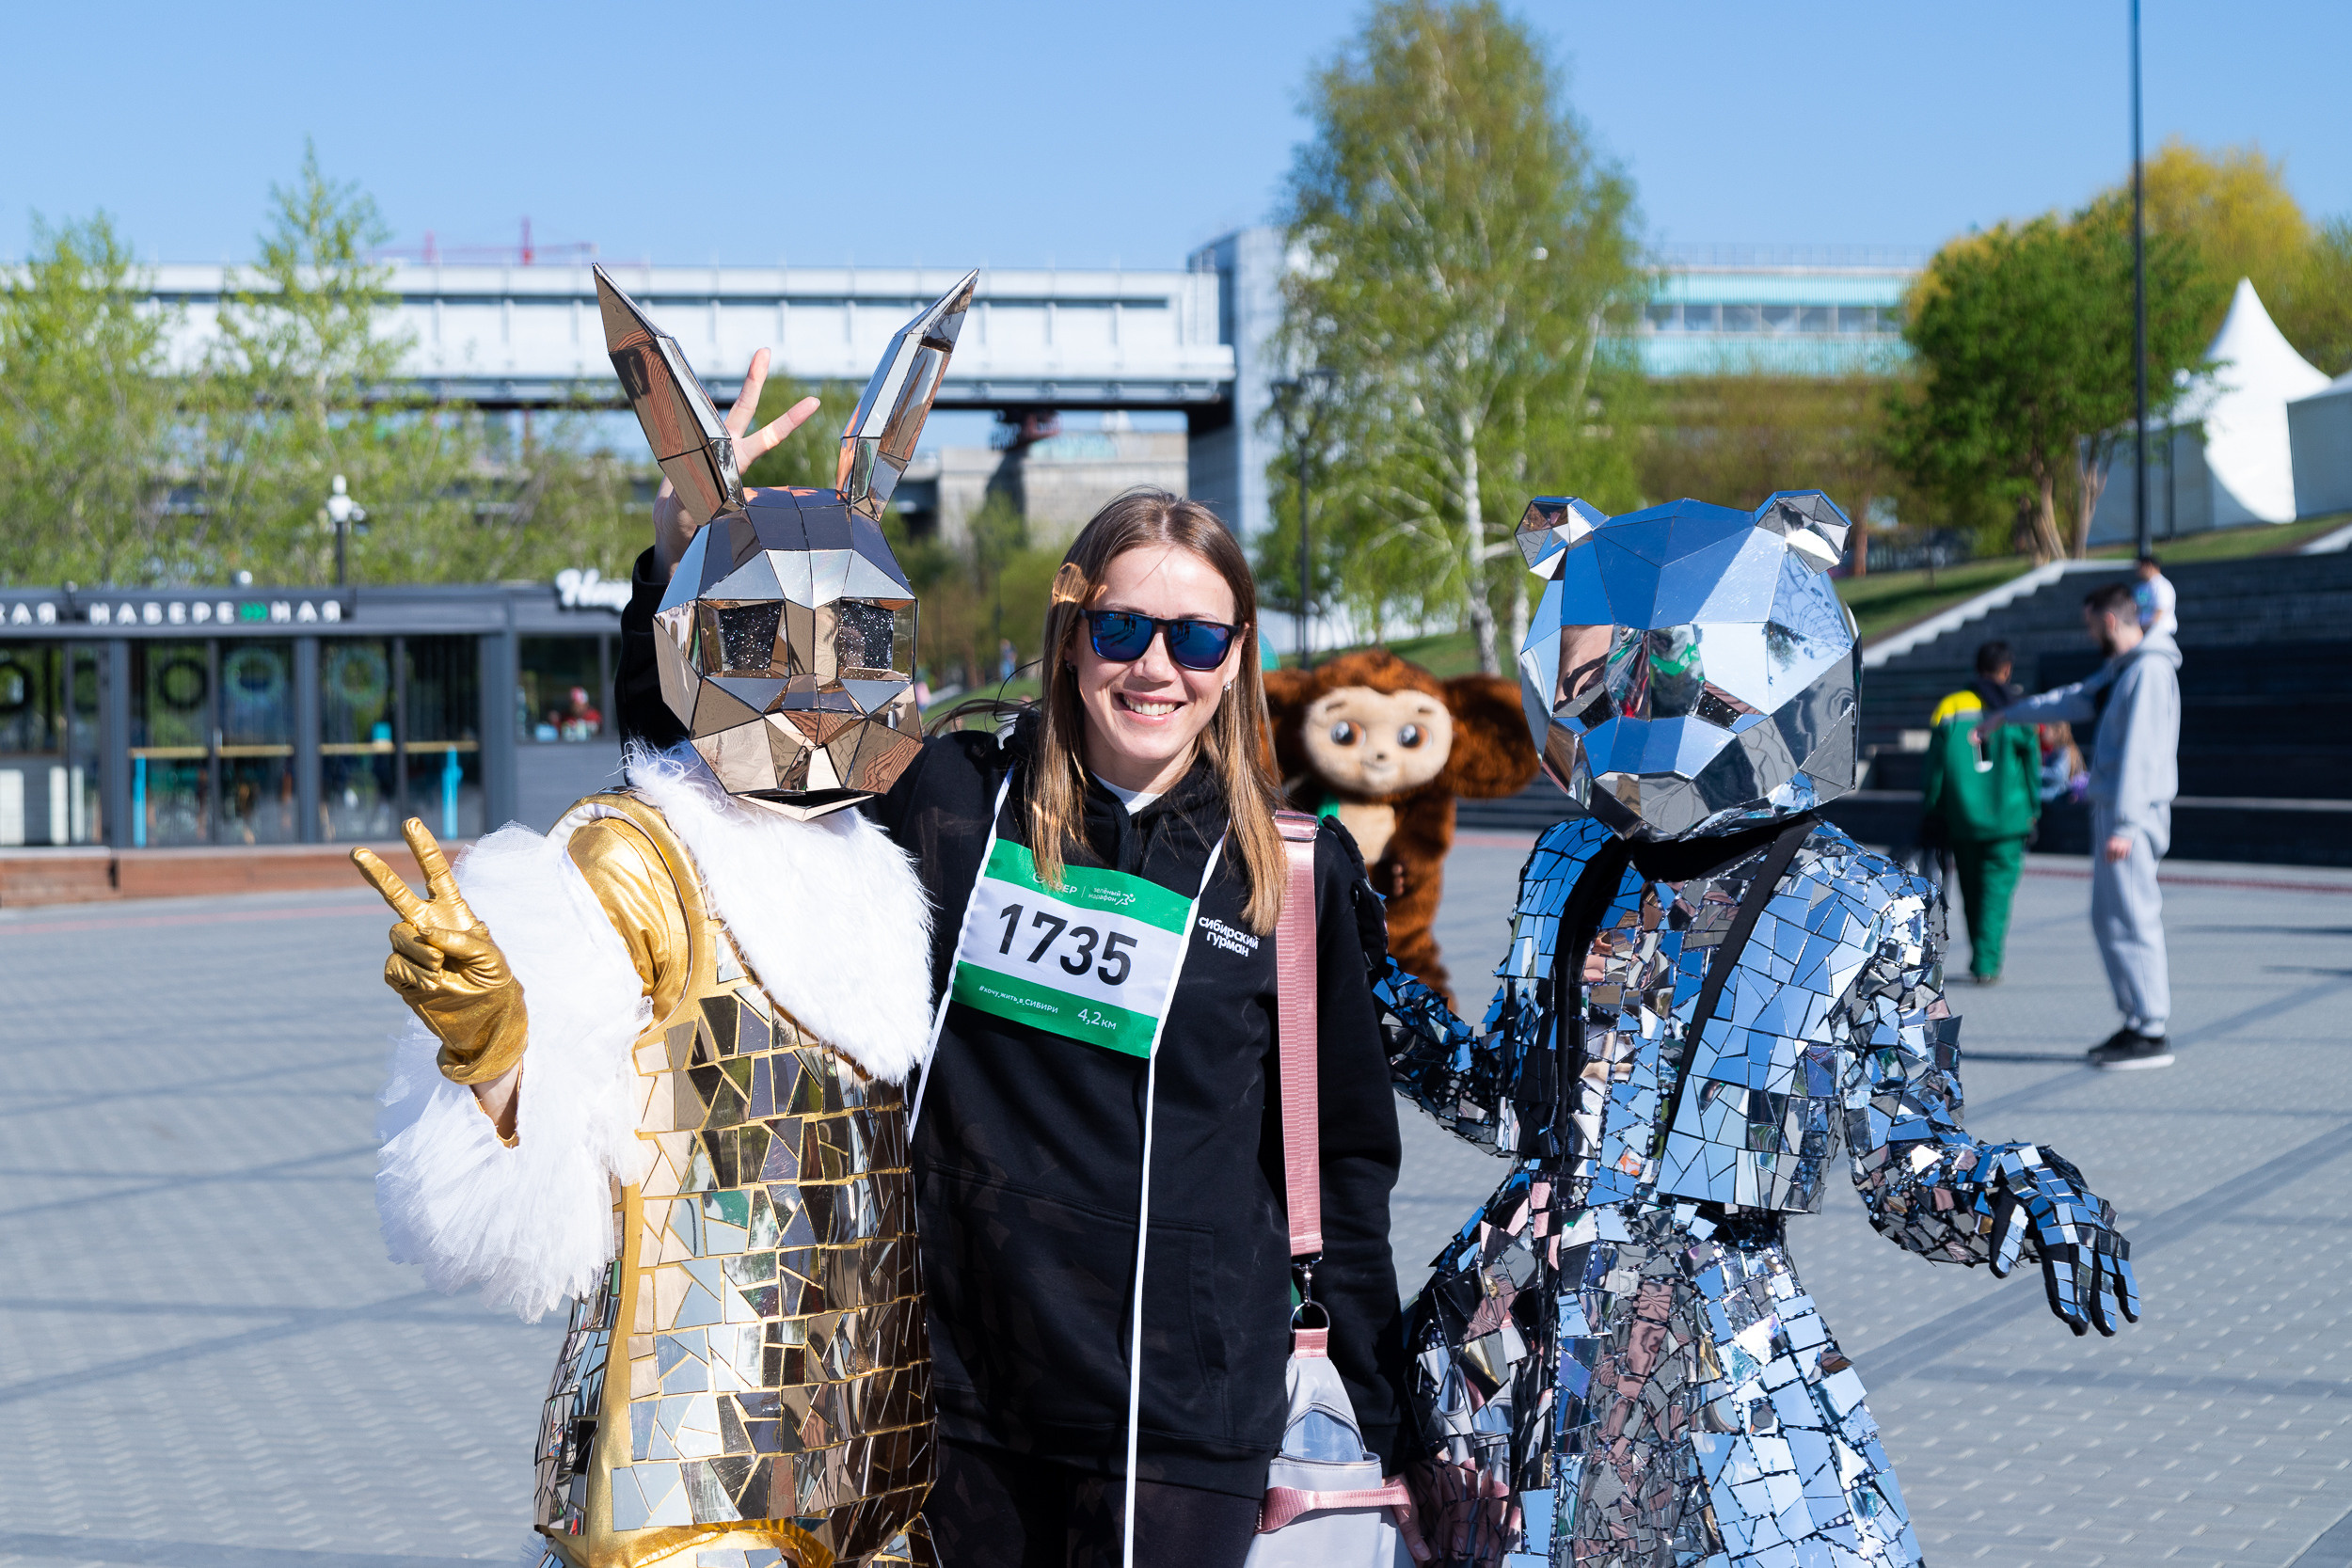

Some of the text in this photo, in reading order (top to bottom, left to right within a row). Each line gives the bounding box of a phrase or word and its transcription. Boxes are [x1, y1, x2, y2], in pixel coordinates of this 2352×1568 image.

[1088, 893, 1117, 903] марафон
[999, 903, 1138, 986] 1735
[1198, 916, 1261, 950] сибирский
[1206, 931, 1249, 958] гурман
